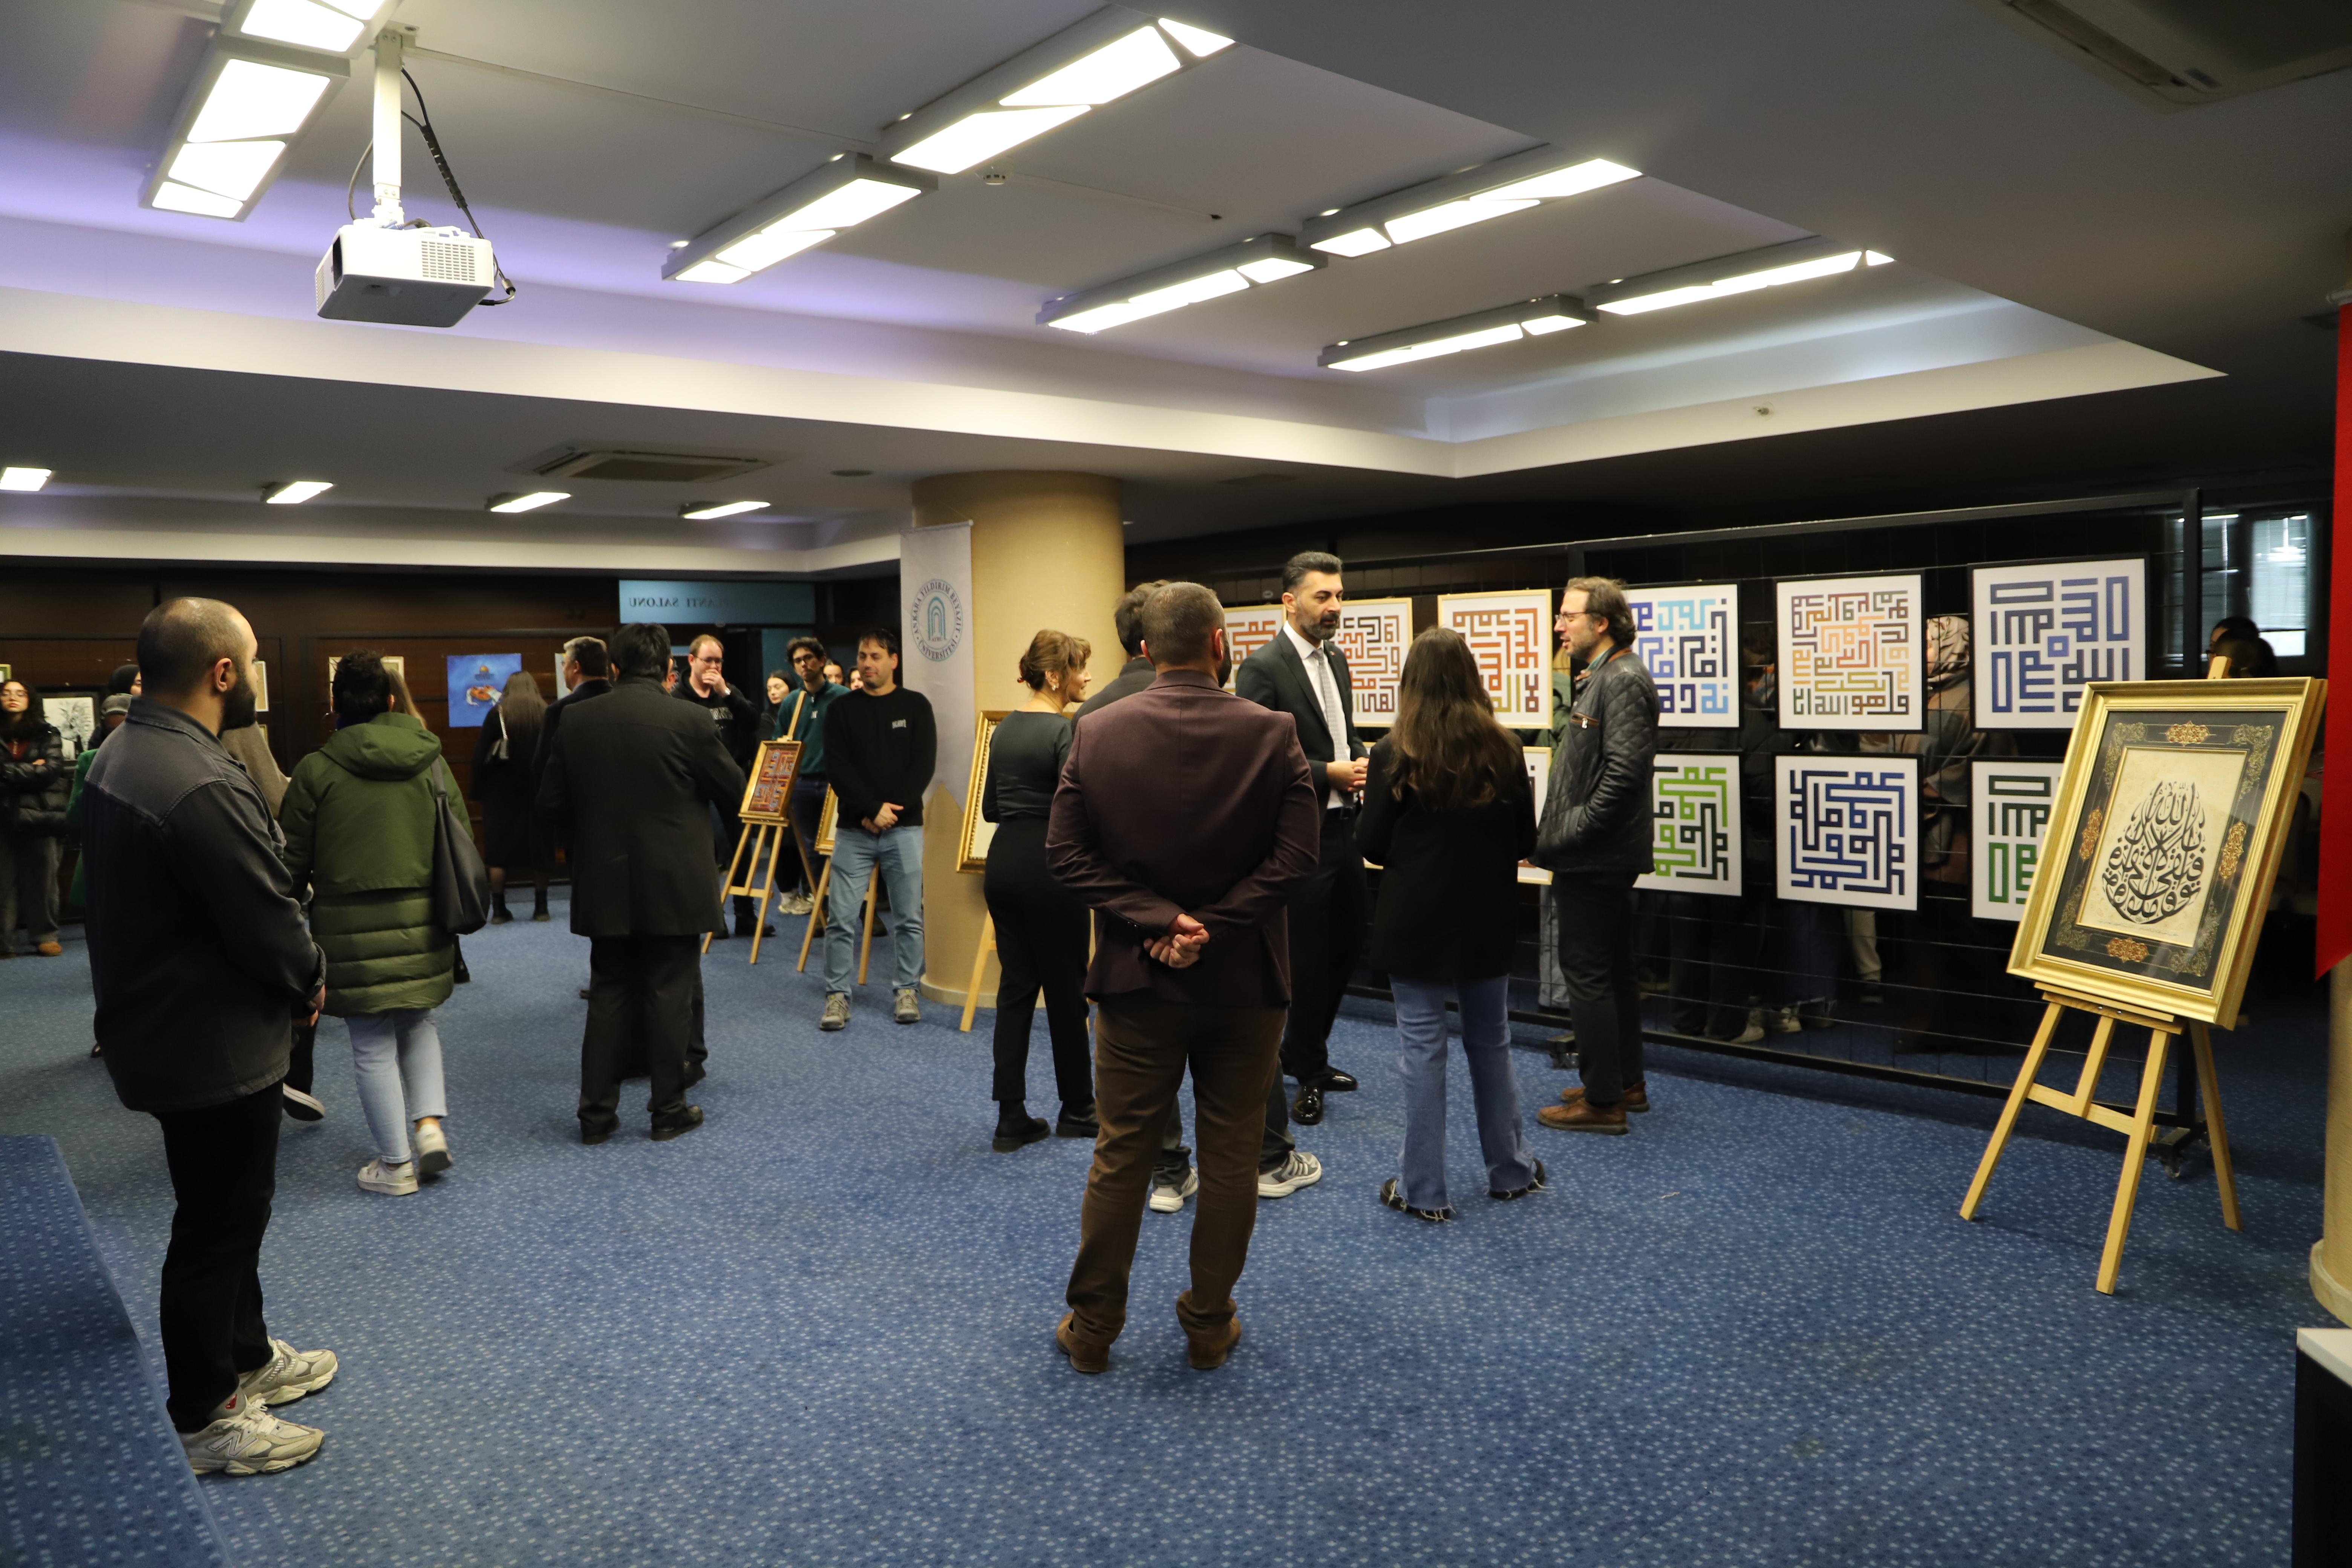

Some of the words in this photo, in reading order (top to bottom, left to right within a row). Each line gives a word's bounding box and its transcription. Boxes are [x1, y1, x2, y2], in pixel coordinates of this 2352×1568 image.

[913, 598, 922, 633] ANKARA
[920, 582, 950, 596] YILDIRIM
[950, 593, 962, 633] BEYAZIT
[918, 638, 957, 660] ÜNİVERSİTESİ
